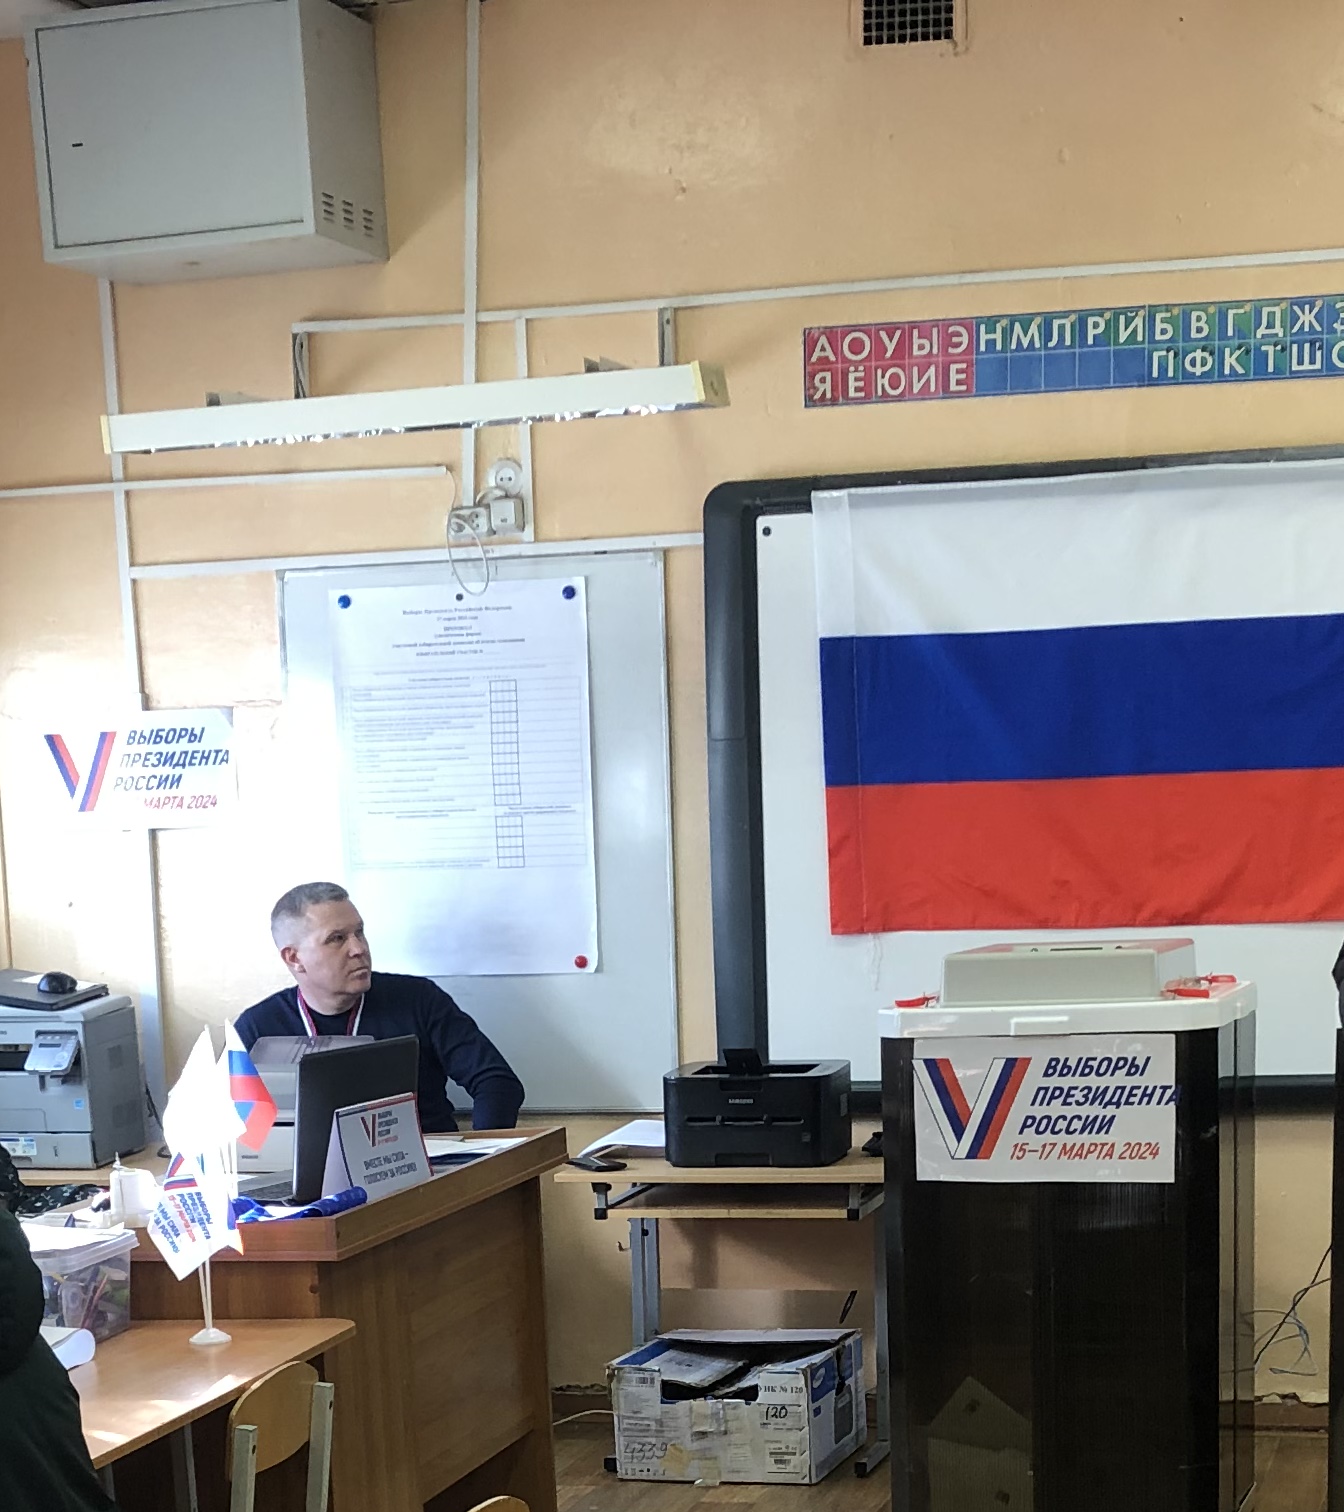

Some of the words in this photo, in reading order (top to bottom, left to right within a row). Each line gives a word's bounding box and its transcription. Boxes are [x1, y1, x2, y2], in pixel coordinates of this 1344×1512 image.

[810, 334, 836, 362] А
[843, 331, 870, 360] О
[879, 329, 902, 358] У
[912, 327, 938, 356] Ы
[948, 325, 969, 354] Э
[979, 323, 1002, 352] Н
[1010, 321, 1040, 350] М
[1048, 318, 1072, 348] Л
[1087, 315, 1106, 345] Р
[1119, 311, 1144, 343] Й
[1155, 312, 1173, 341] Б
[1190, 310, 1209, 339] В
[1227, 308, 1246, 337] Г
[1256, 306, 1284, 339] Д
[1291, 304, 1322, 334] Ж
[813, 371, 832, 400] Я
[848, 366, 865, 398] Ё
[876, 366, 906, 396] Ю
[912, 364, 936, 394] И
[949, 363, 967, 392] Е
[1152, 350, 1174, 378] П
[1184, 349, 1214, 376] Ф
[1224, 346, 1246, 375] К
[1261, 344, 1282, 373] Т
[1291, 342, 1322, 371] Ш
[126, 727, 205, 745] ВЫБОРЫ
[119, 748, 230, 769] ПРЕЗИДЕНТА
[113, 773, 183, 792] РОССИИ
[187, 794, 218, 809] 2024
[1042, 1056, 1151, 1078] ВЫБОРЫ
[1030, 1084, 1182, 1109] ПРЕЗИДЕНТА
[1018, 1114, 1116, 1135] РОССИИ
[1057, 1142, 1116, 1161] МАРТА
[1118, 1142, 1160, 1160] 2024
[790, 1386, 804, 1394] 120
[765, 1406, 788, 1421] 120
